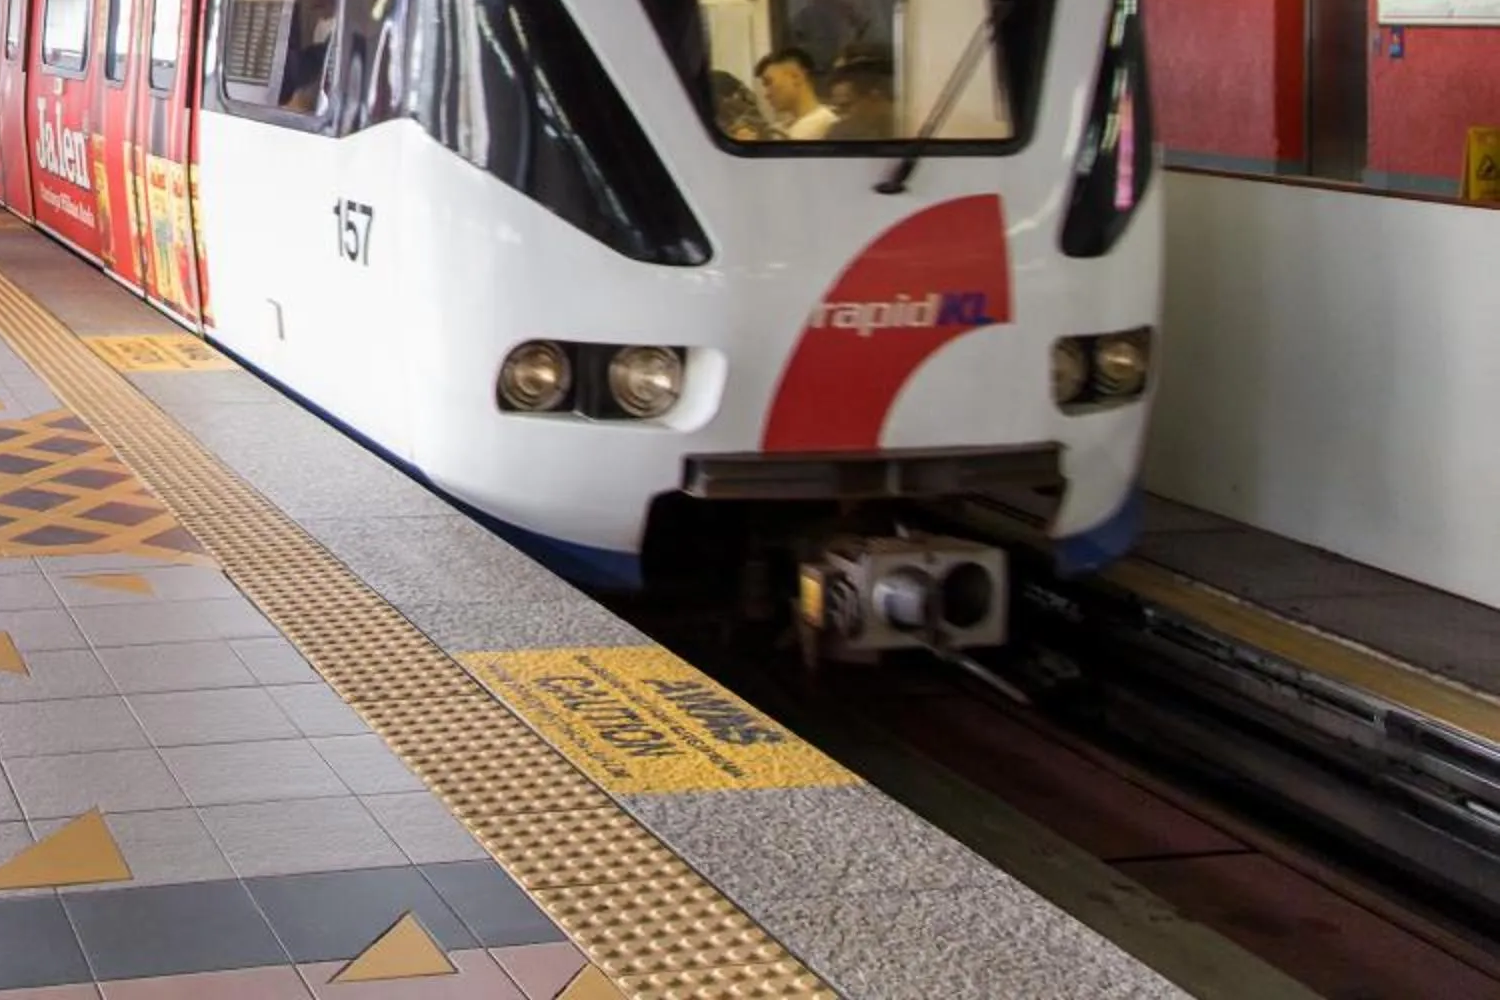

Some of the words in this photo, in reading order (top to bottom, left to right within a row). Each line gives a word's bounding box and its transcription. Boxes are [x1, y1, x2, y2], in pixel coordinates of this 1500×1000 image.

[332, 196, 374, 267] 157
[809, 291, 996, 338] rapidKL
[531, 674, 688, 757] CAUTION
